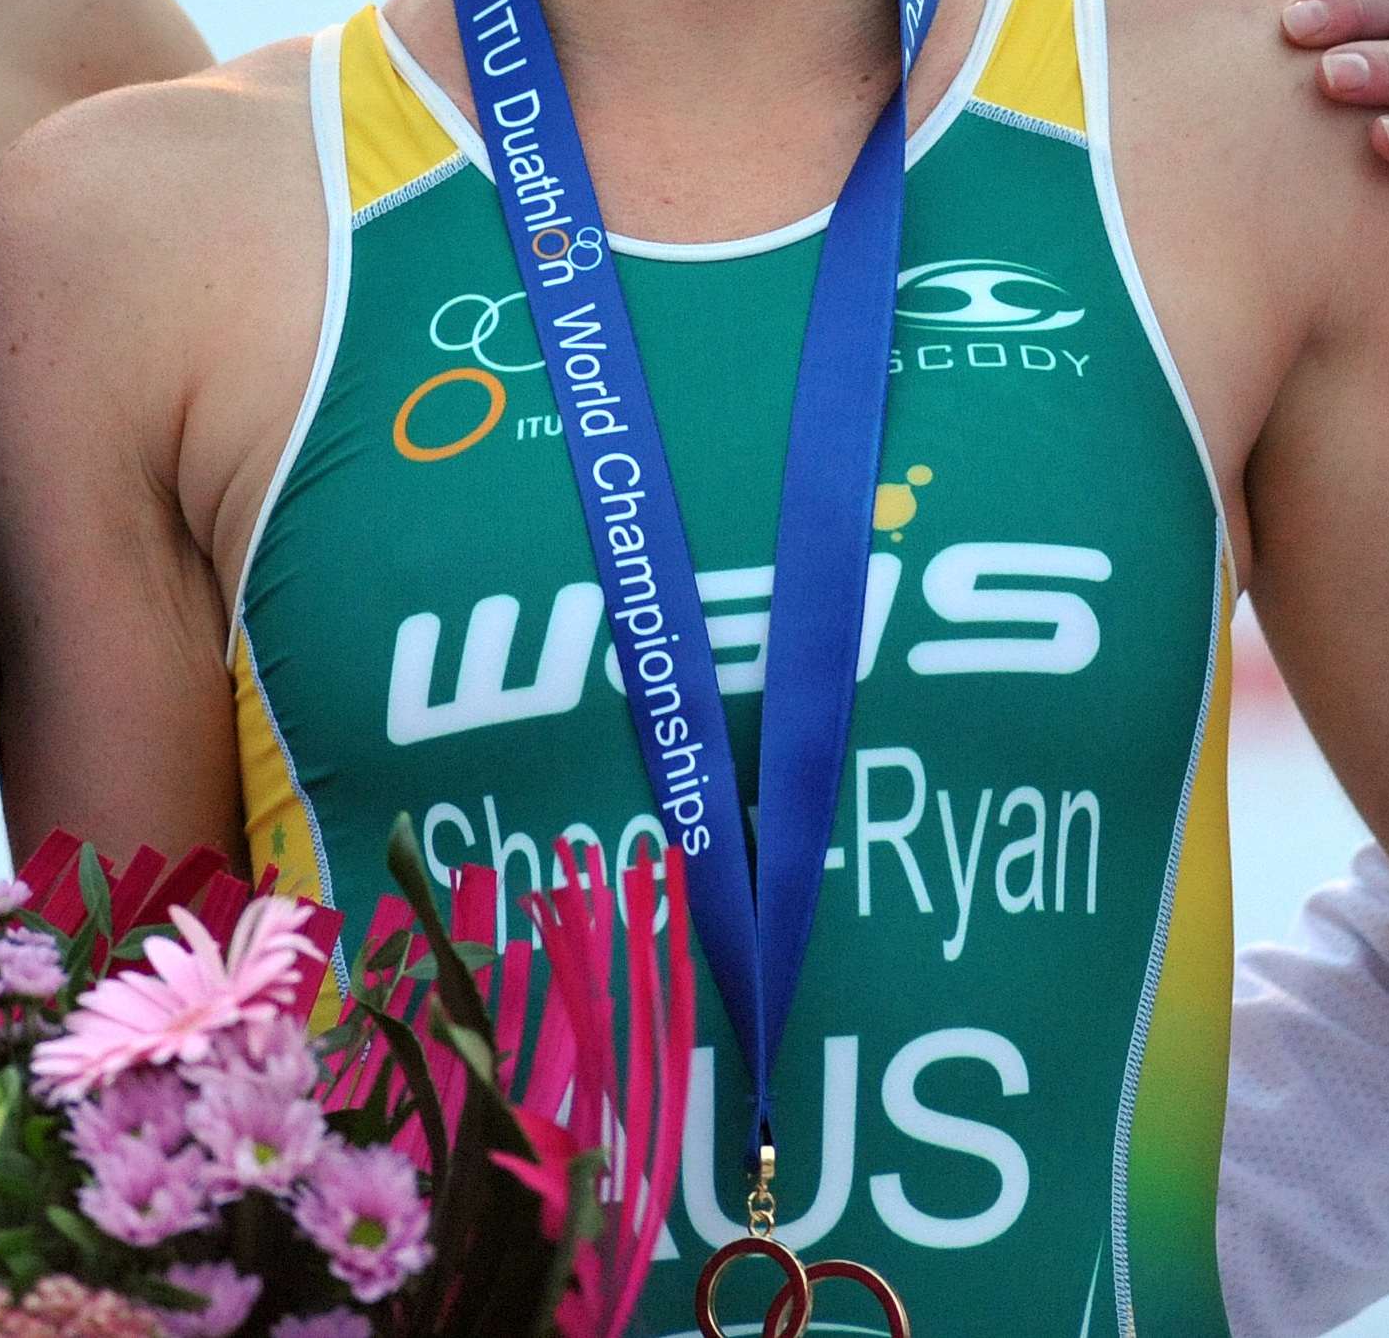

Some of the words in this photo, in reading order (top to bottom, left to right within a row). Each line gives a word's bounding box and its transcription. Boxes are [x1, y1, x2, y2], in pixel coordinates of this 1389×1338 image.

[493, 88, 575, 288] Duathlon
[552, 302, 630, 439] World
[592, 451, 712, 858] Championships
[517, 414, 563, 441] ITU
[566, 1025, 1032, 1261] US
